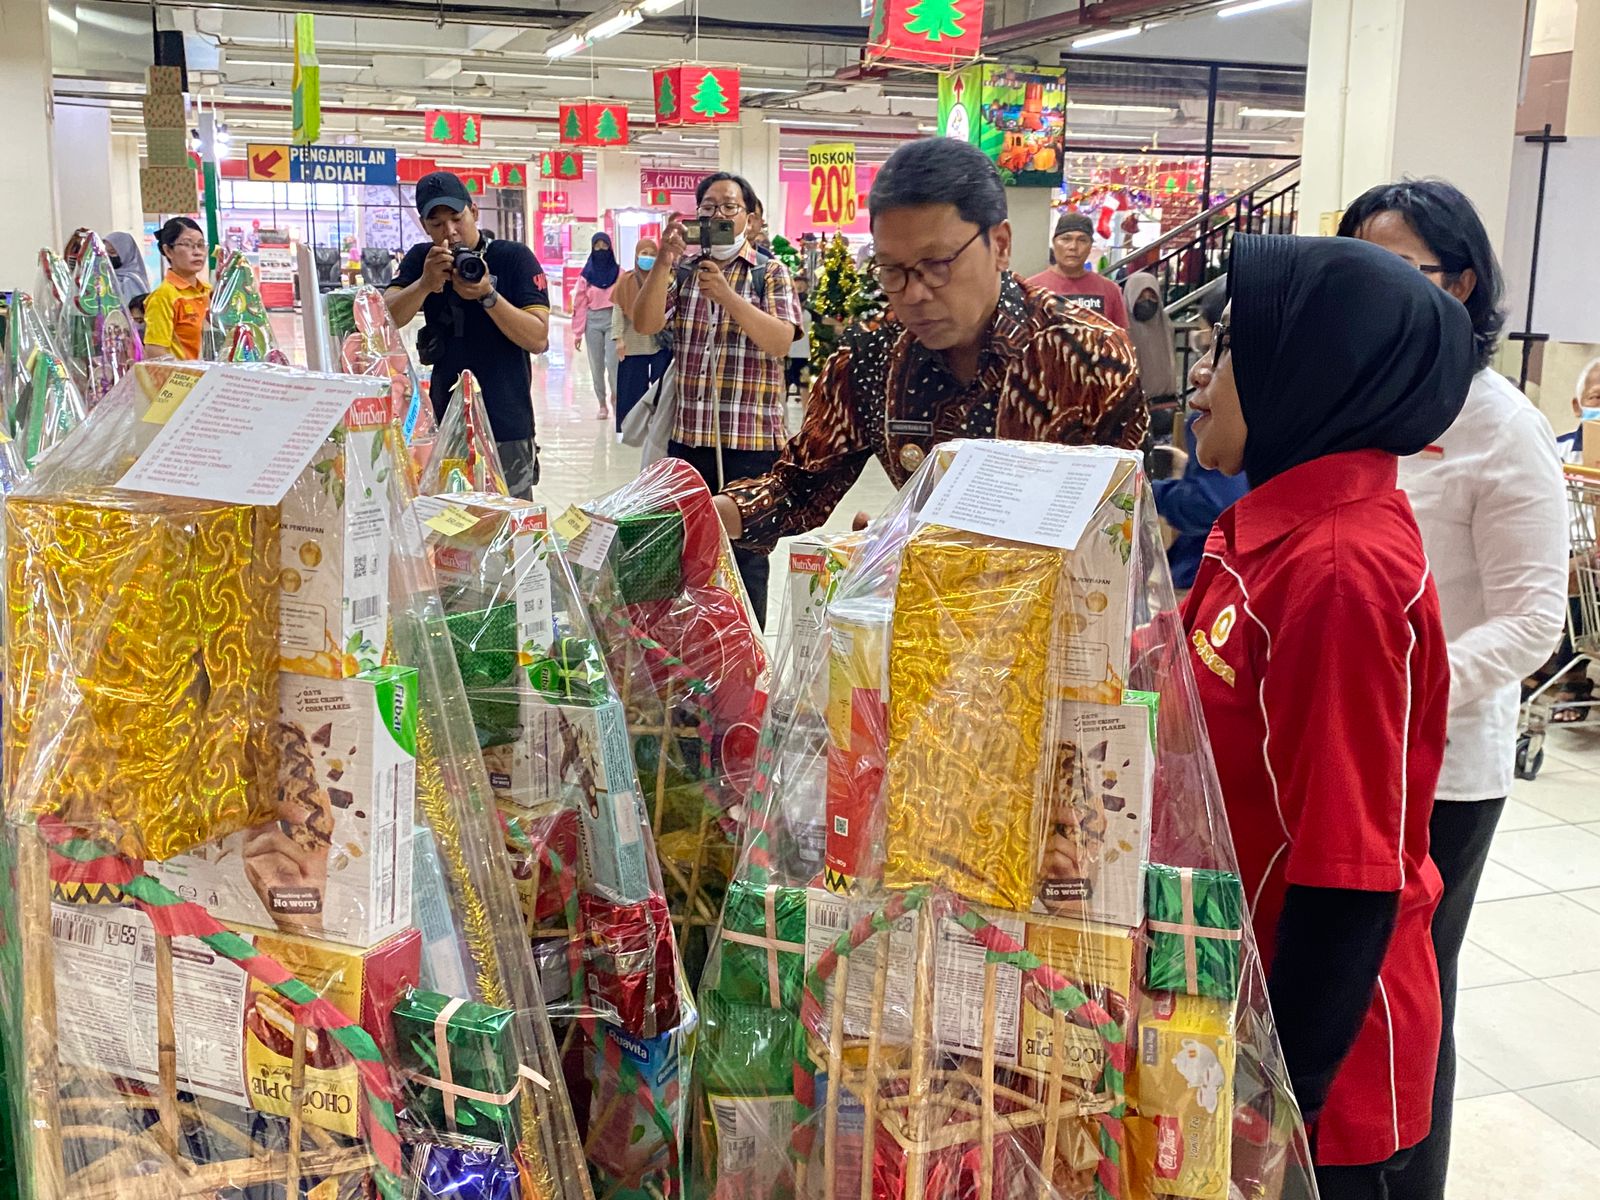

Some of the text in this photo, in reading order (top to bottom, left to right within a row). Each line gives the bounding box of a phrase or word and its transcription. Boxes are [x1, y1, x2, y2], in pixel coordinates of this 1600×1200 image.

[290, 147, 385, 165] PENGAMBILAN
[810, 152, 854, 165] DISKON
[656, 174, 695, 189] GALLERY
[811, 165, 855, 222] 20%
[1077, 298, 1101, 309] light
[350, 402, 387, 425] NutriSari
[514, 518, 543, 531] NtriSari
[394, 684, 404, 731] Fitbar
[1045, 887, 1089, 897] No worry
[273, 898, 318, 910] No worry
[1025, 1038, 1054, 1057] PIE
[251, 1077, 281, 1100] PIE
